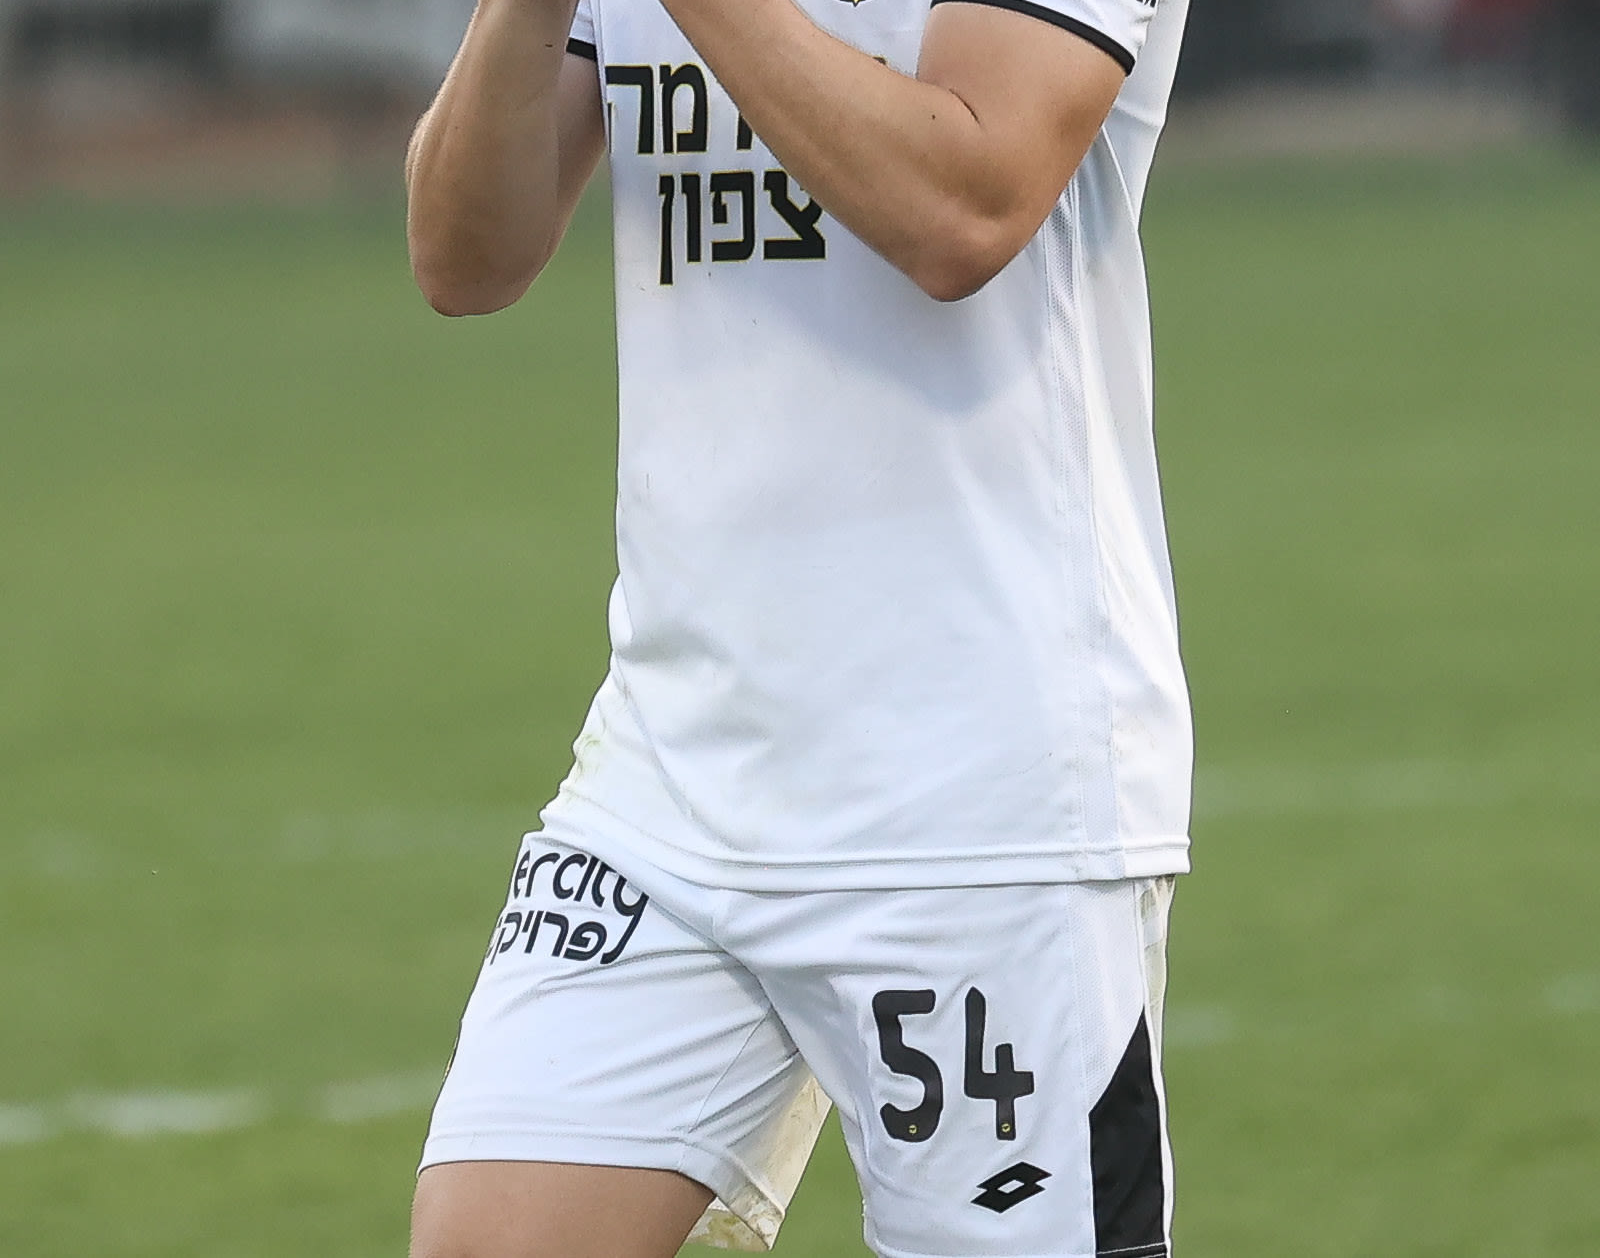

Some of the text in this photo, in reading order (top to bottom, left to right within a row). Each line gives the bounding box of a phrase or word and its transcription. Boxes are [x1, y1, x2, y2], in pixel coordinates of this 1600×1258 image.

[658, 169, 826, 285] צפון
[486, 910, 607, 965] פרויק
[872, 986, 1035, 1143] 54
